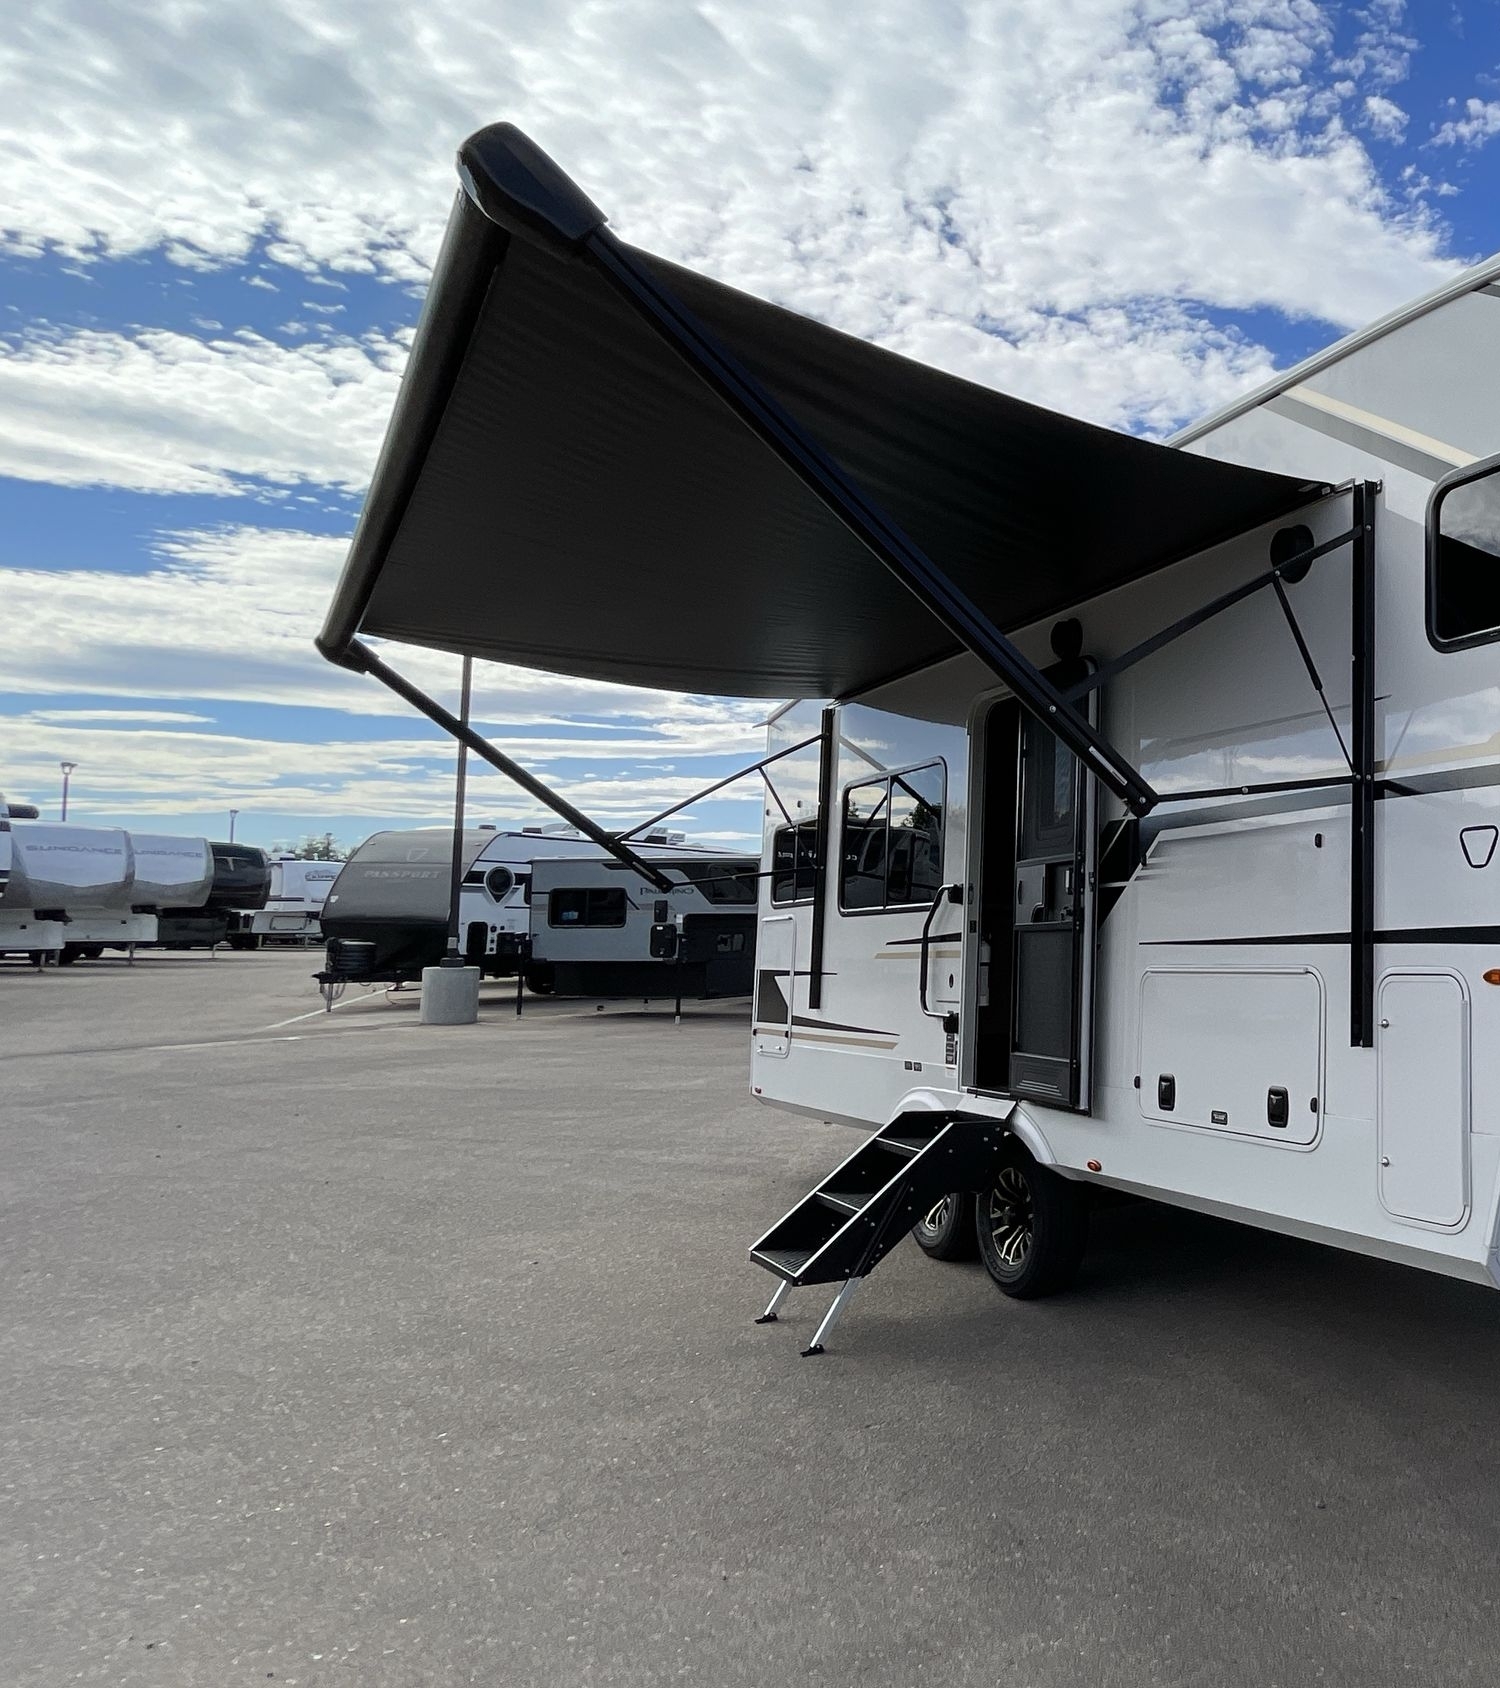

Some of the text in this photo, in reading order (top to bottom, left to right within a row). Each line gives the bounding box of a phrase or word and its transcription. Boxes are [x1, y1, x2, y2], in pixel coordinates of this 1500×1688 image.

[25, 844, 123, 855] SUNDANCE
[134, 848, 204, 858] UNDANCE
[363, 870, 441, 879] PASSPORT
